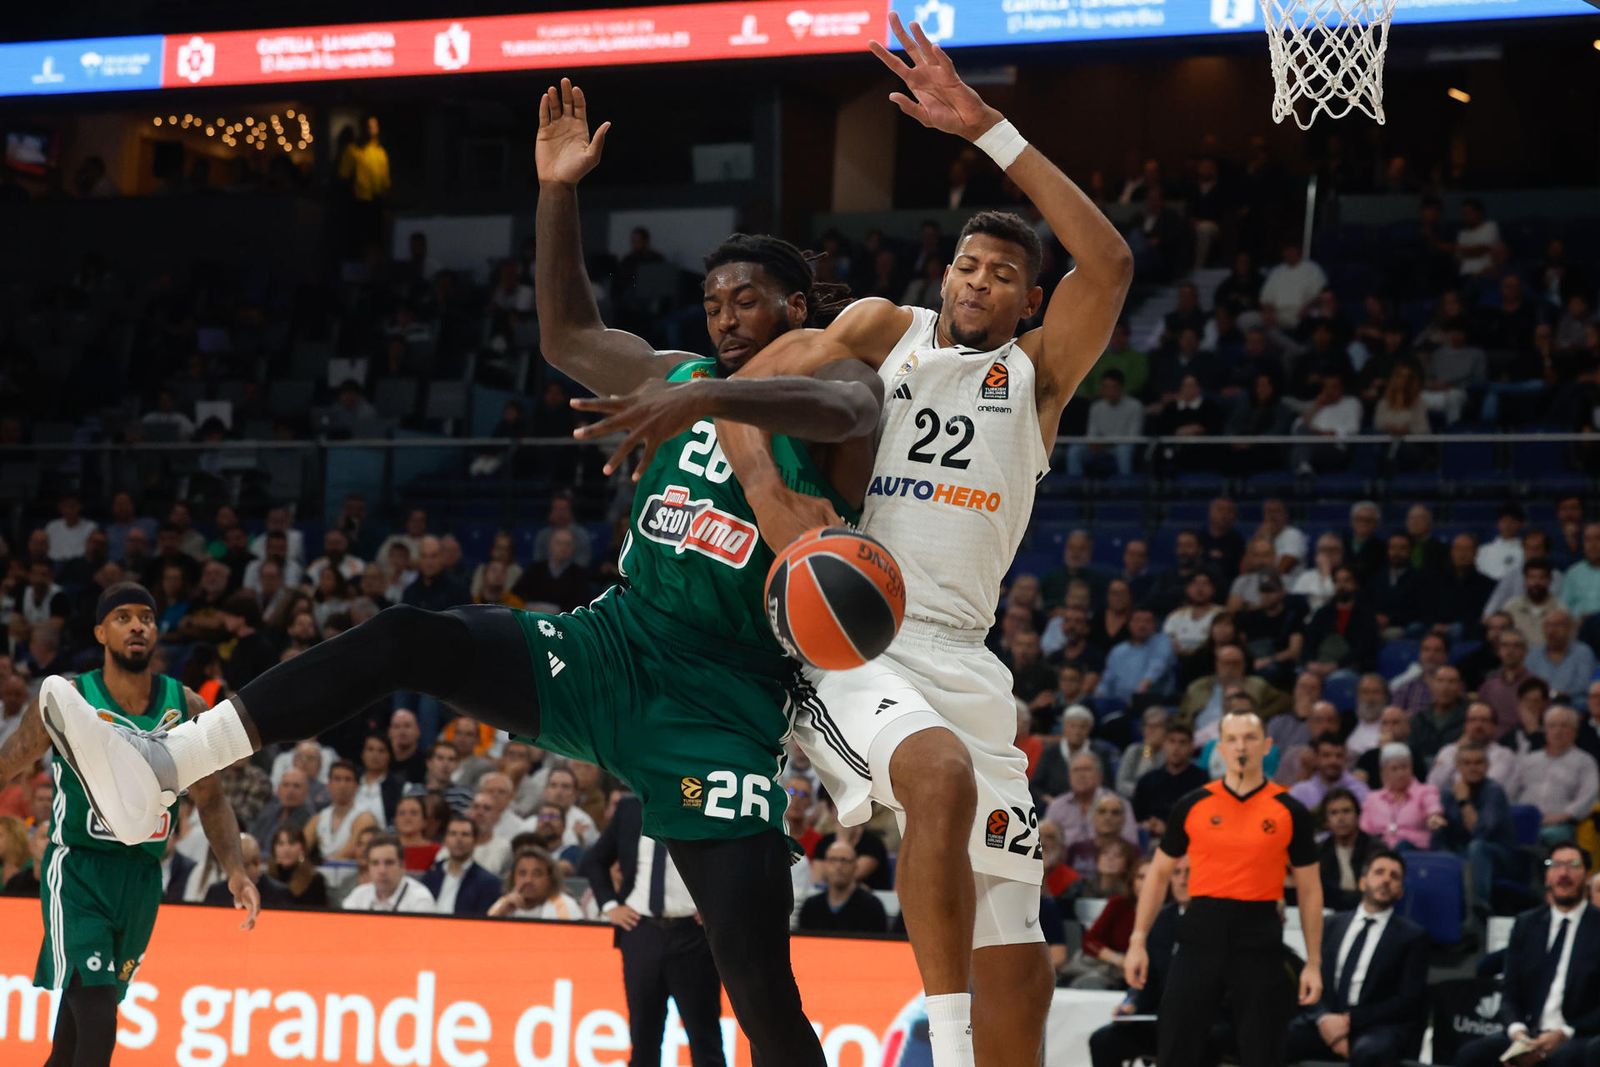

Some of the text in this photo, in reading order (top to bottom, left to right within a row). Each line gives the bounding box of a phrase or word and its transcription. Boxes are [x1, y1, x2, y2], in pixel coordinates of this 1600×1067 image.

[977, 405, 1012, 414] oneteam
[907, 407, 975, 470] 22
[867, 476, 1001, 513] AUTOHERO
[704, 770, 771, 823] 26
[0, 974, 159, 1050] ms
[175, 970, 492, 1067] grande
[514, 978, 632, 1067] de
